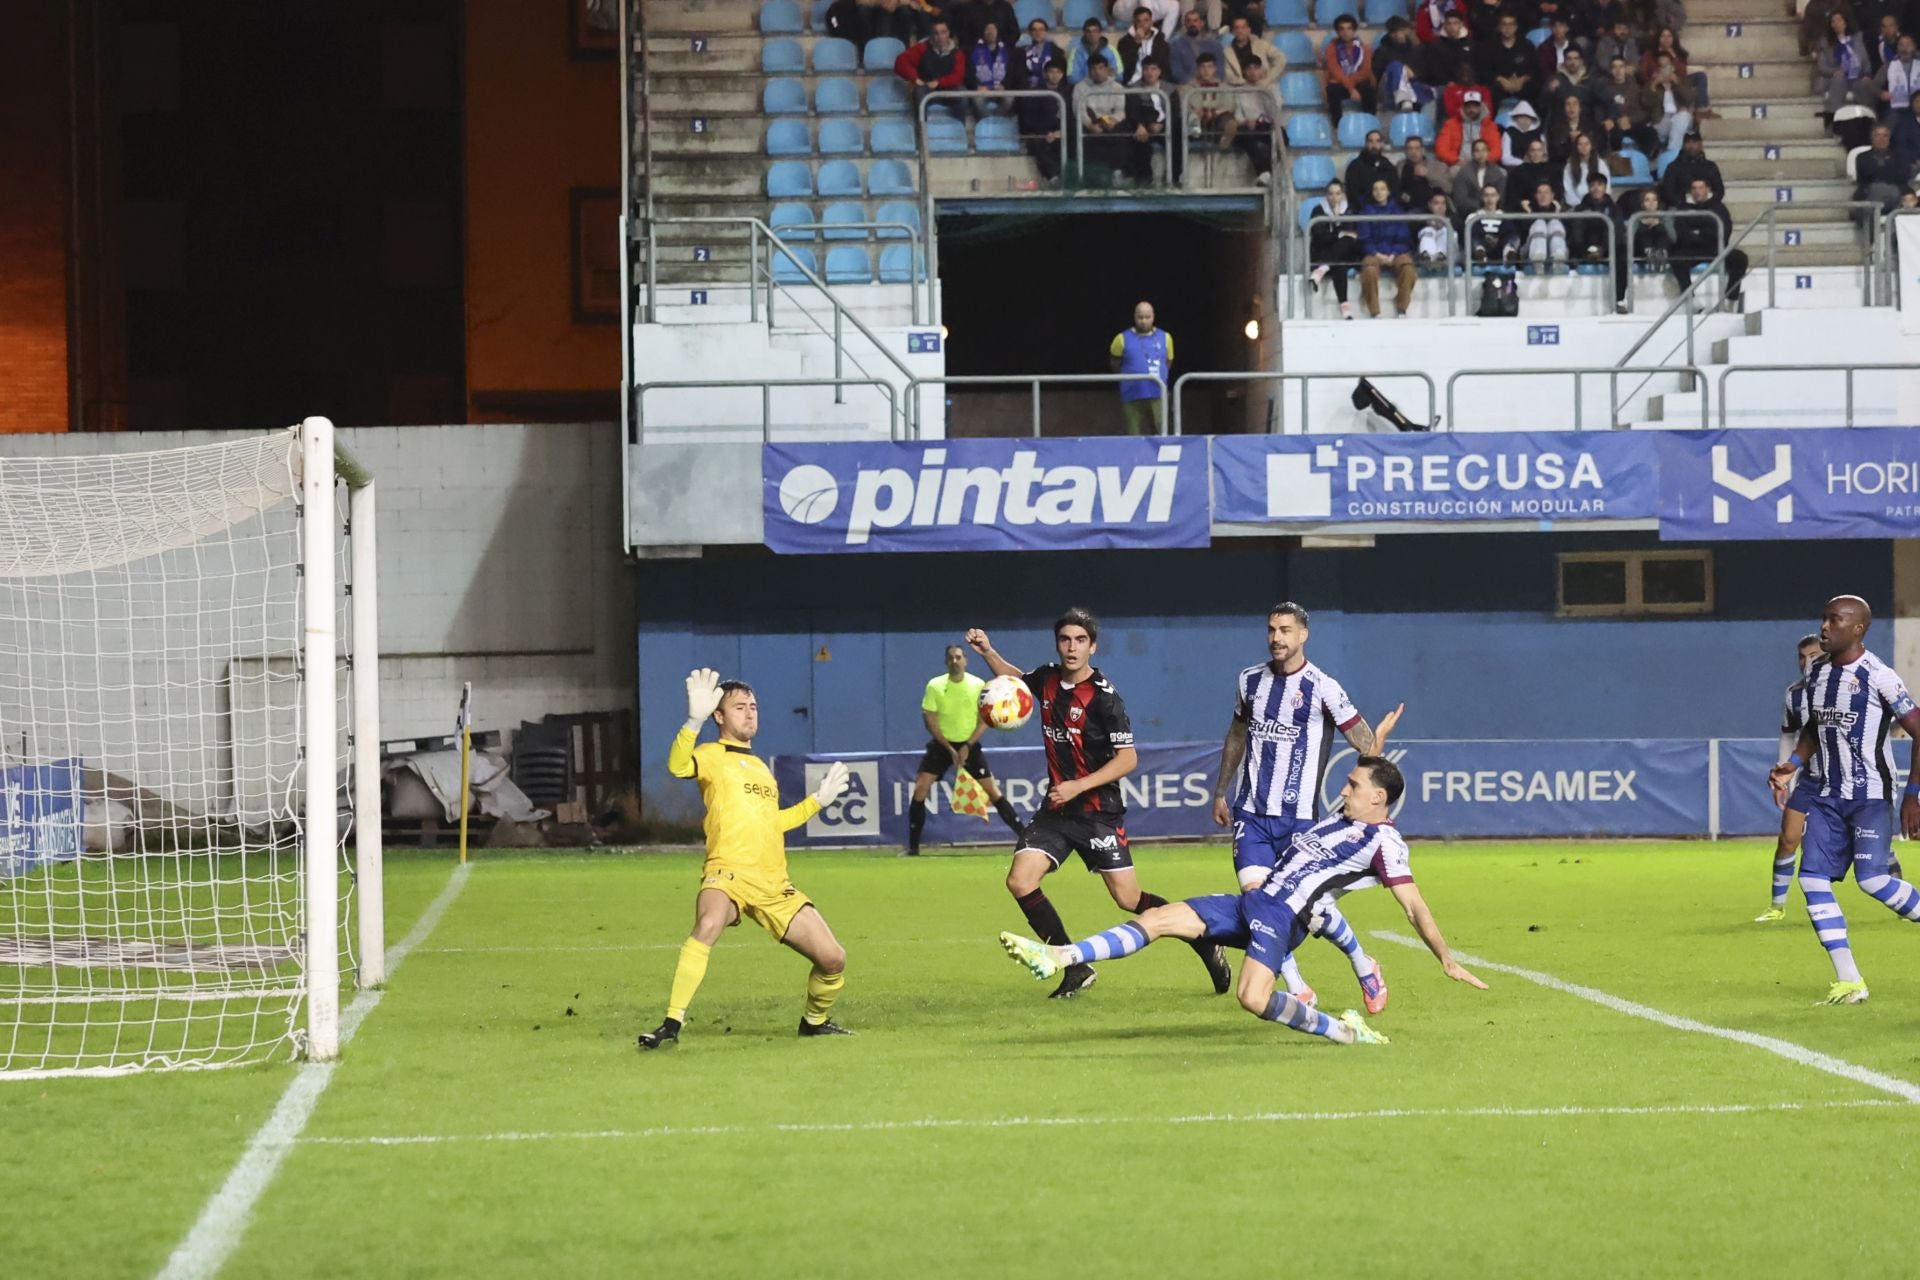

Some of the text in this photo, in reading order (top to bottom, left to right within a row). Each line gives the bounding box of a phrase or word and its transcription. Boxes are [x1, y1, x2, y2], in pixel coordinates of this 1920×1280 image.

[1730, 26, 1737, 37] 7
[695, 40, 702, 52] 7
[1741, 66, 1750, 78] 6
[1754, 107, 1763, 119] 5
[694, 120, 702, 132] 5
[1767, 149, 1776, 160] 4
[1780, 190, 1788, 201] 3
[1788, 233, 1797, 245] 2
[697, 249, 706, 261] 2
[1799, 277, 1806, 289] 1
[695, 293, 702, 304] 1
[1347, 453, 1604, 492] PRECUSA
[1827, 462, 1918, 494] HORI
[845, 445, 1182, 544] pintavi
[1348, 498, 1604, 515] CONSTRUCCIÓN MODULAR
[1422, 770, 1638, 802] FRESAMEX
[819, 798, 867, 826] CC
